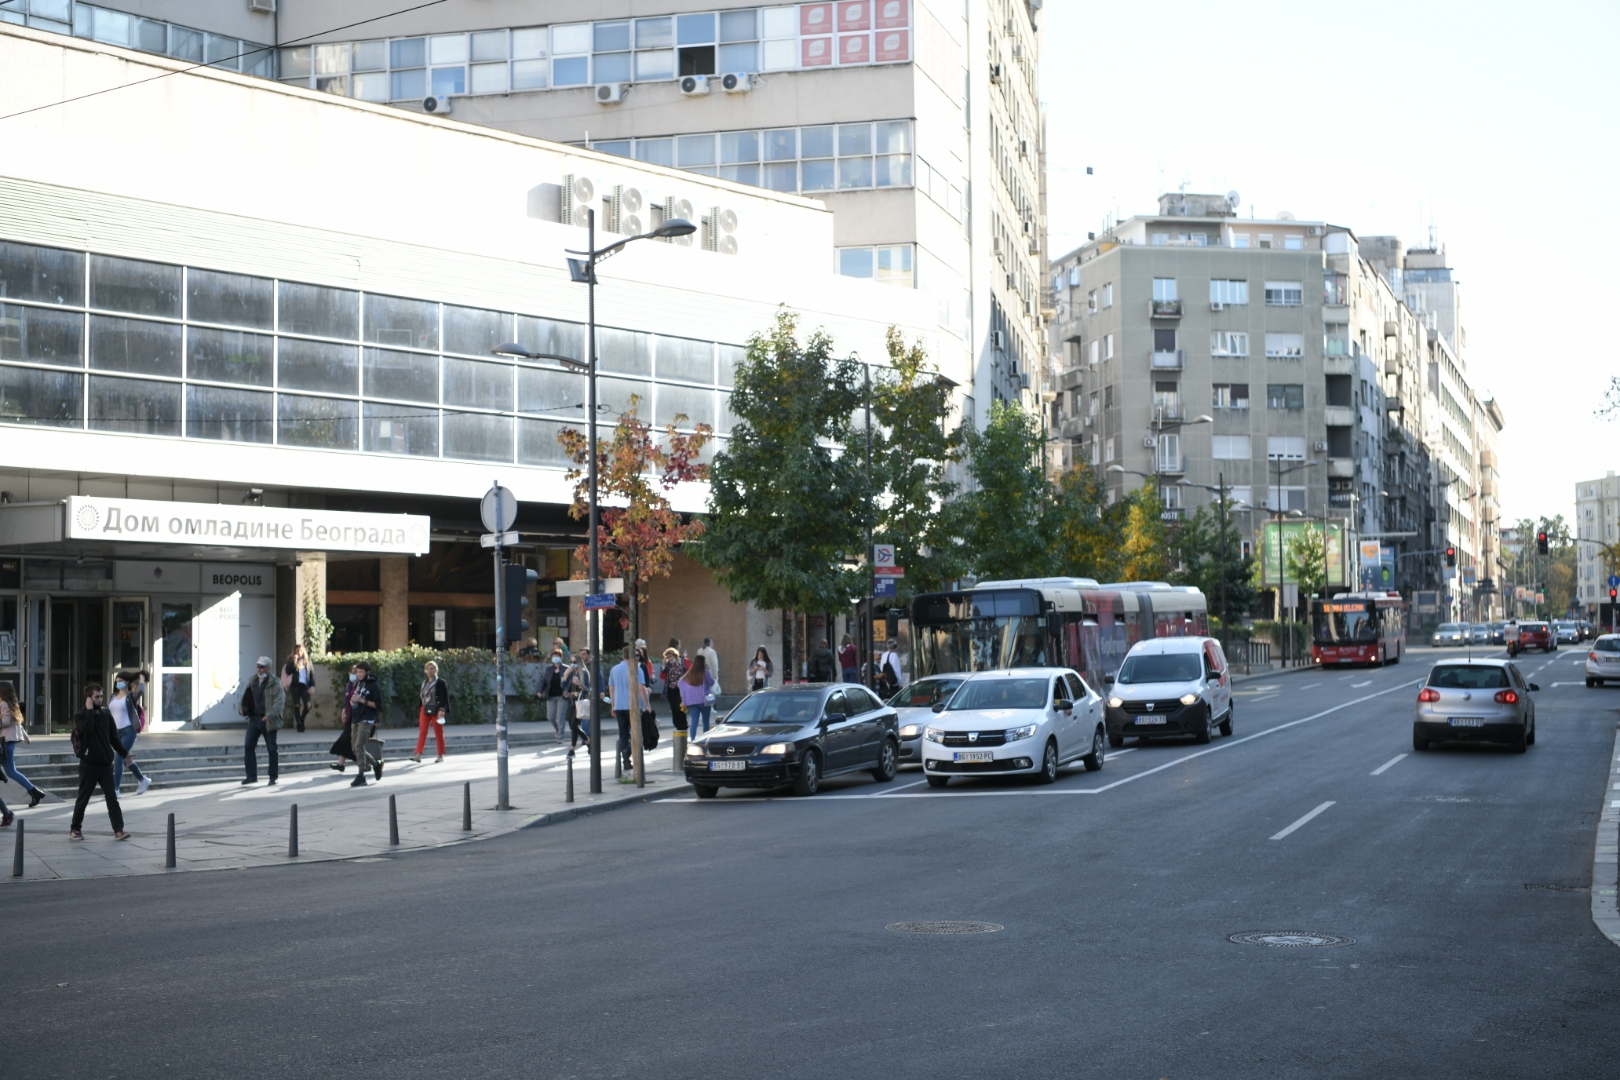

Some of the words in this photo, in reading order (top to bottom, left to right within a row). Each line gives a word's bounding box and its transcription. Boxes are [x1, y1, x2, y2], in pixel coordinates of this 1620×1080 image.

[103, 507, 160, 534] Дом
[168, 517, 294, 540] омладине
[300, 518, 406, 547] Београда
[212, 574, 262, 586] BEOPOLIS
